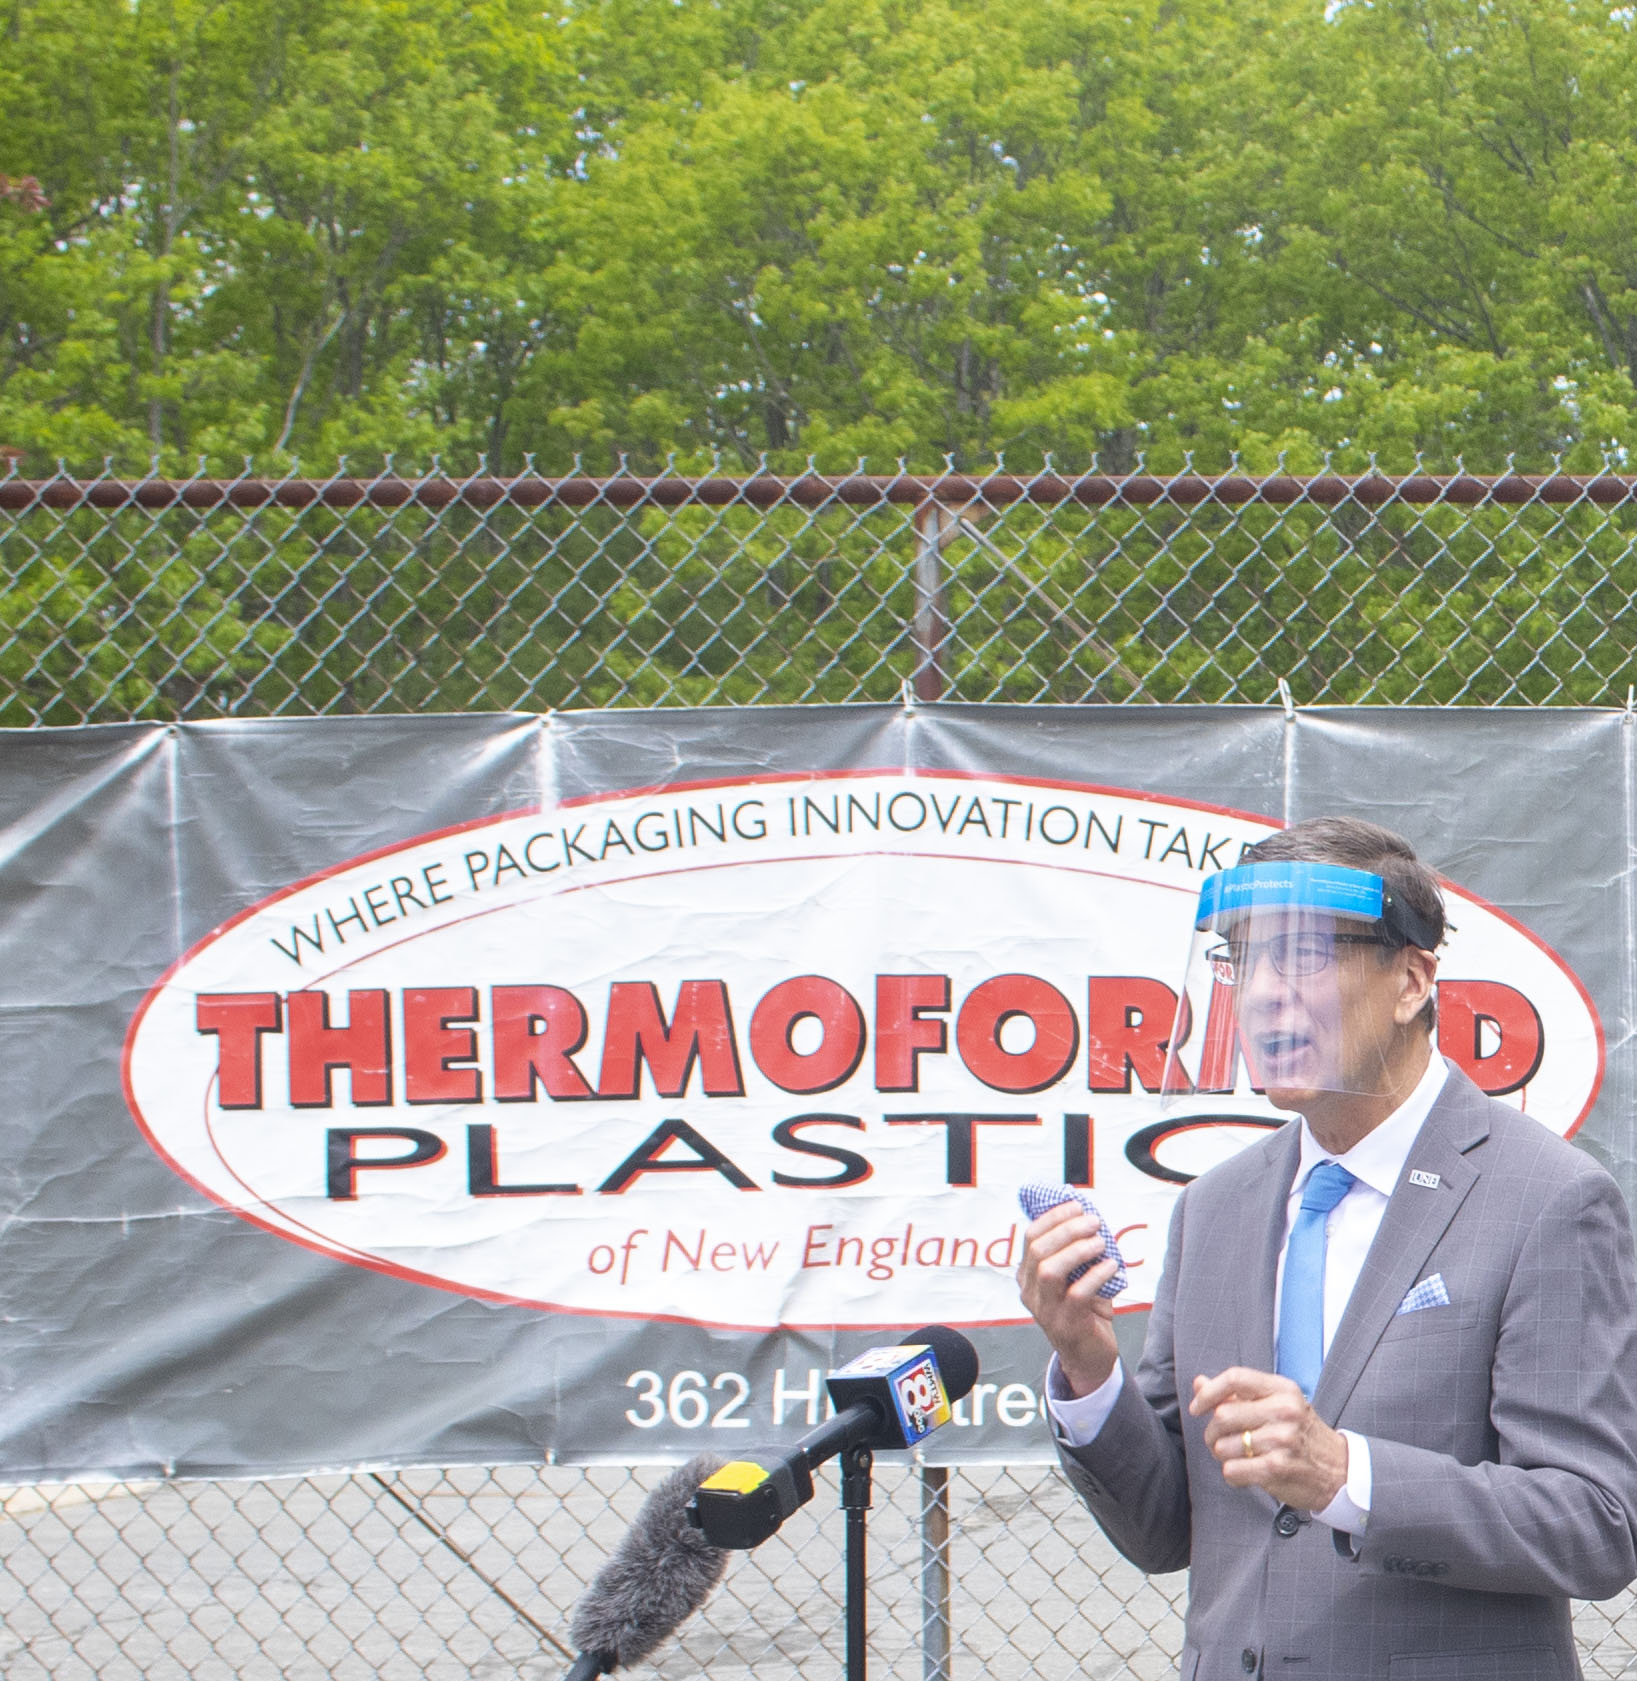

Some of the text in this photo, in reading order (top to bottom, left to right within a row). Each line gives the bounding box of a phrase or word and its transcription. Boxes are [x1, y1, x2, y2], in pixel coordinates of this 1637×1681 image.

[271, 790, 1257, 967] WHERE PACKAGING INNOVATION TAK
[196, 973, 1545, 1111] THERMOFORD
[325, 1112, 1293, 1201] PLASTIC
[587, 1230, 647, 1286] of
[662, 1228, 781, 1274] New
[802, 1222, 1017, 1281] England
[624, 1369, 751, 1429] 362
